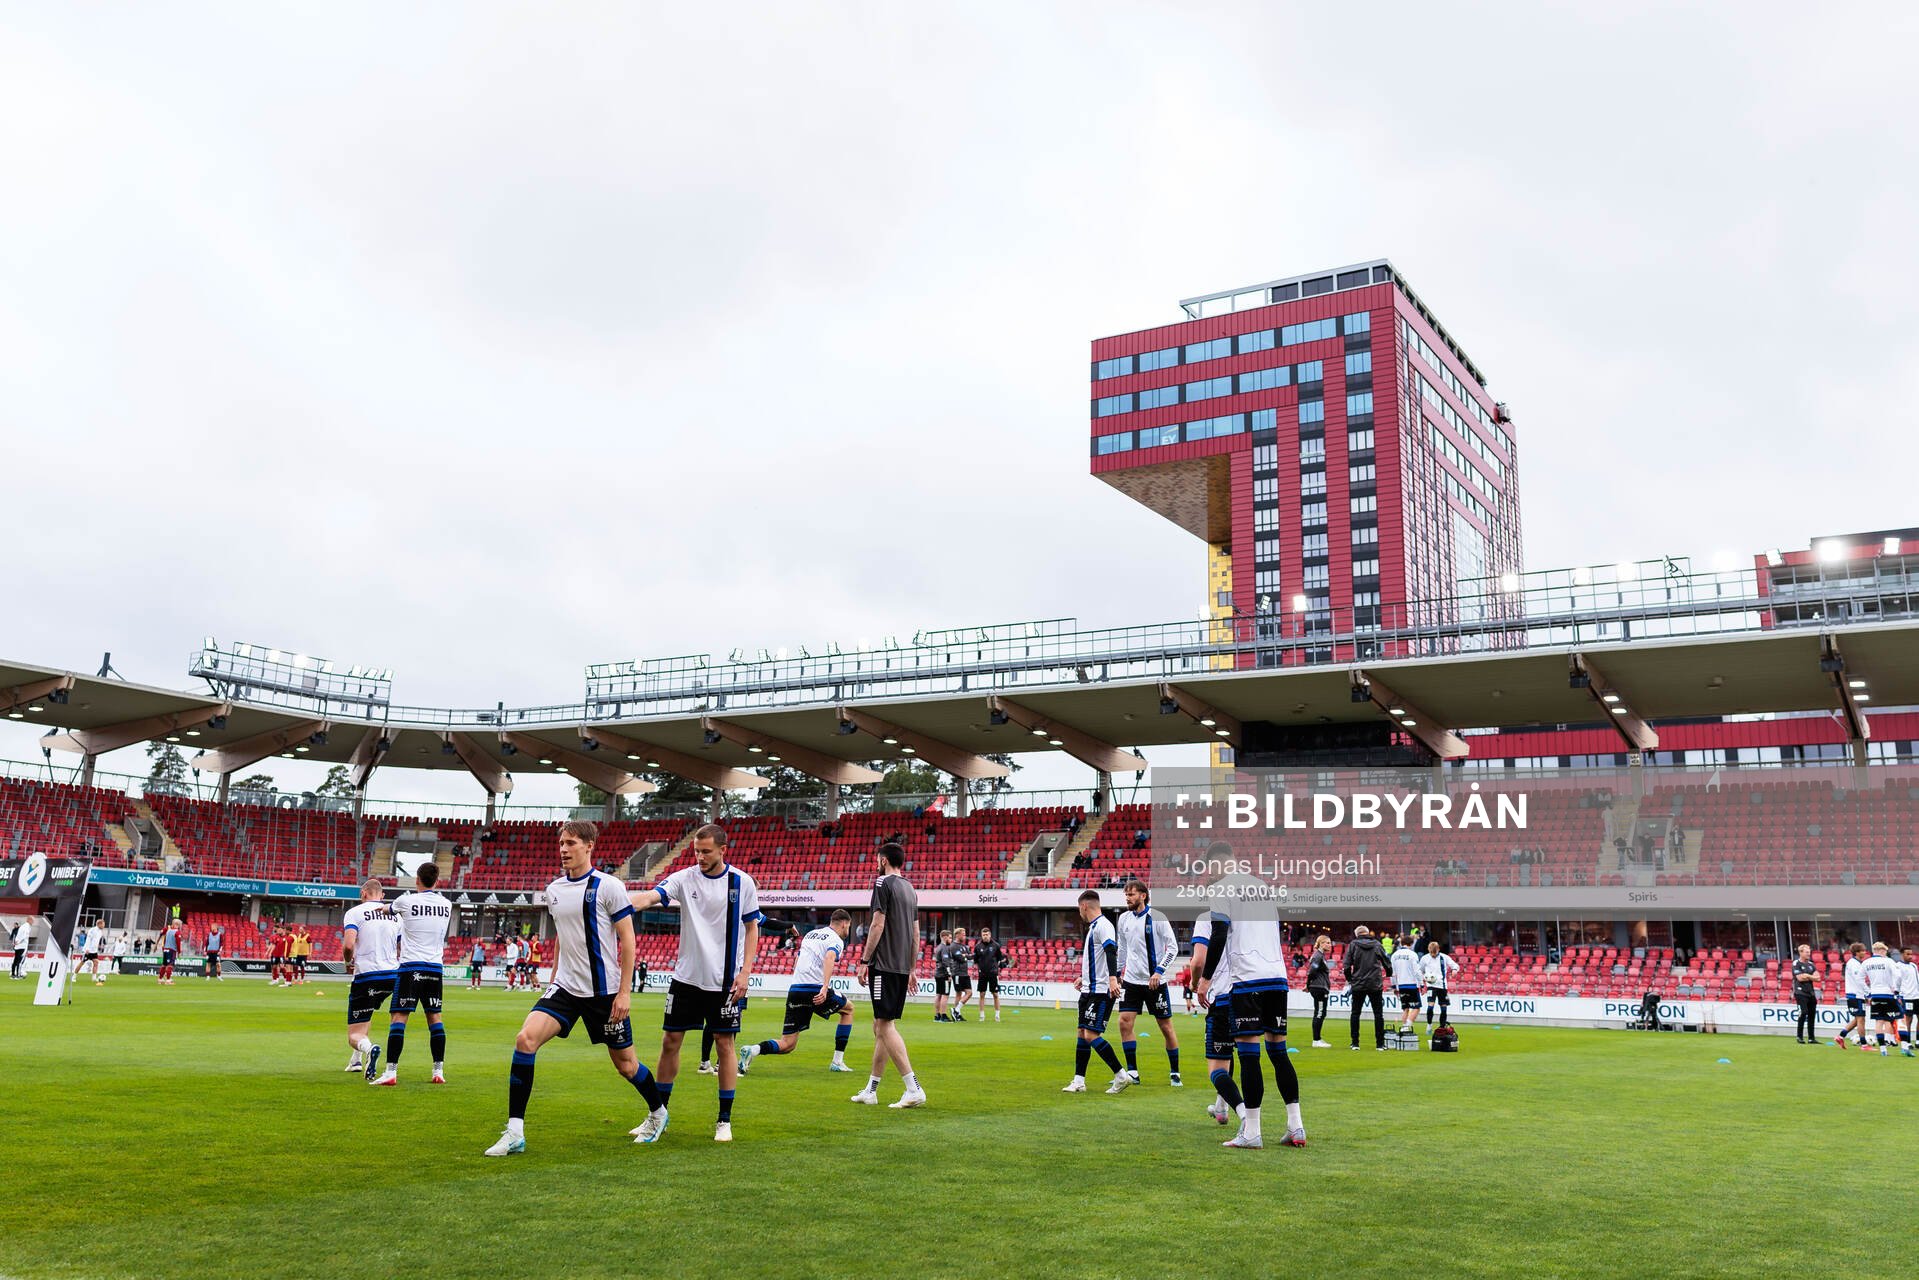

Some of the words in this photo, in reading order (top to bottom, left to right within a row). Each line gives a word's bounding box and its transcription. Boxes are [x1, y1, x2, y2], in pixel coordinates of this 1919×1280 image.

[50, 866, 84, 879] UNIBET
[136, 874, 169, 887] bravida
[302, 885, 337, 897] bravida
[1628, 891, 1659, 903] Spiris
[757, 894, 786, 904] midigare
[978, 893, 999, 904] Spiris
[1292, 892, 1339, 905] Smidigare
[1340, 893, 1382, 904] business.
[411, 904, 450, 918] SIRIUS
[48, 960, 59, 979] U
[1000, 984, 1044, 996] REMON
[1461, 999, 1535, 1013] PREMON
[1605, 1003, 1685, 1018] PREON
